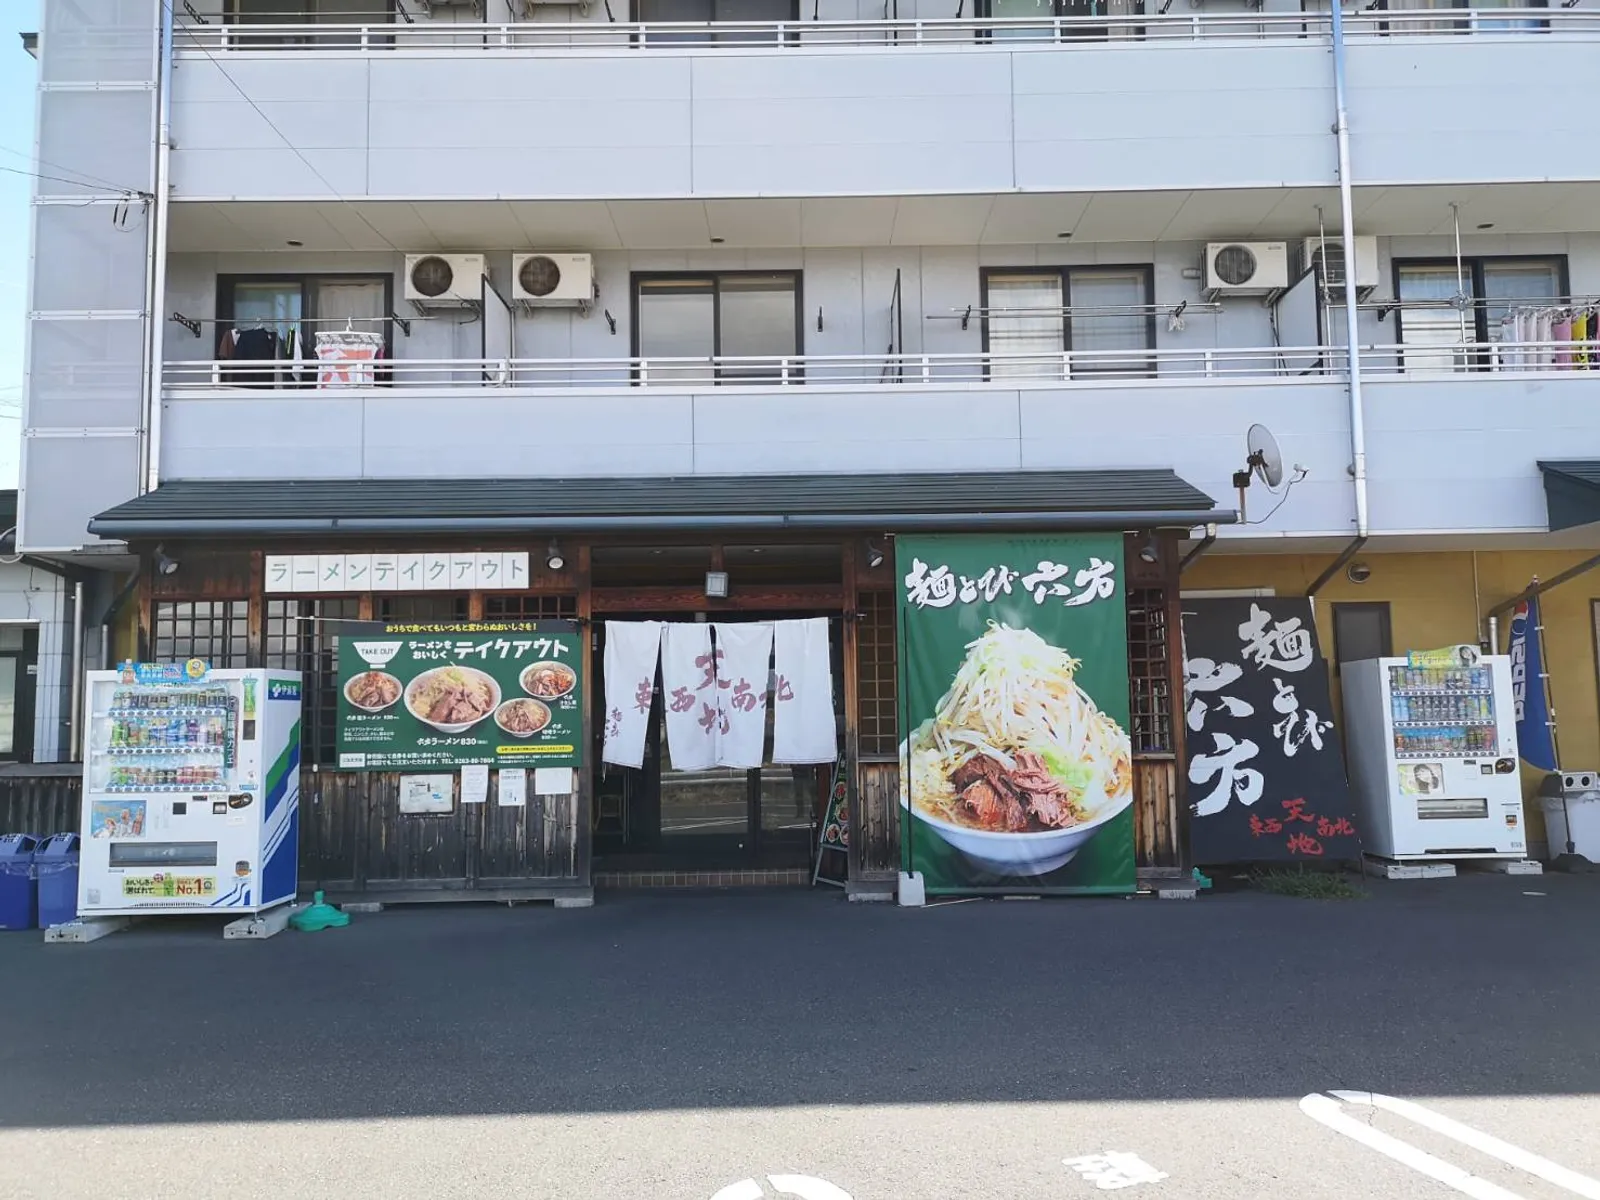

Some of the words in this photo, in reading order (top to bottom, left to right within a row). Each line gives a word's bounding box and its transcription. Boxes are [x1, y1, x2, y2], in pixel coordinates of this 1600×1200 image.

[271, 559, 524, 582] ラーメンテイクアウト
[905, 557, 1115, 609] 麺とび六方
[408, 640, 452, 649] ラーメンを
[454, 638, 569, 659] テイクアウト
[412, 651, 448, 659] おいしく
[1238, 603, 1334, 757] 麺とび
[460, 737, 477, 745] 830
[176, 878, 202, 895] No.1
